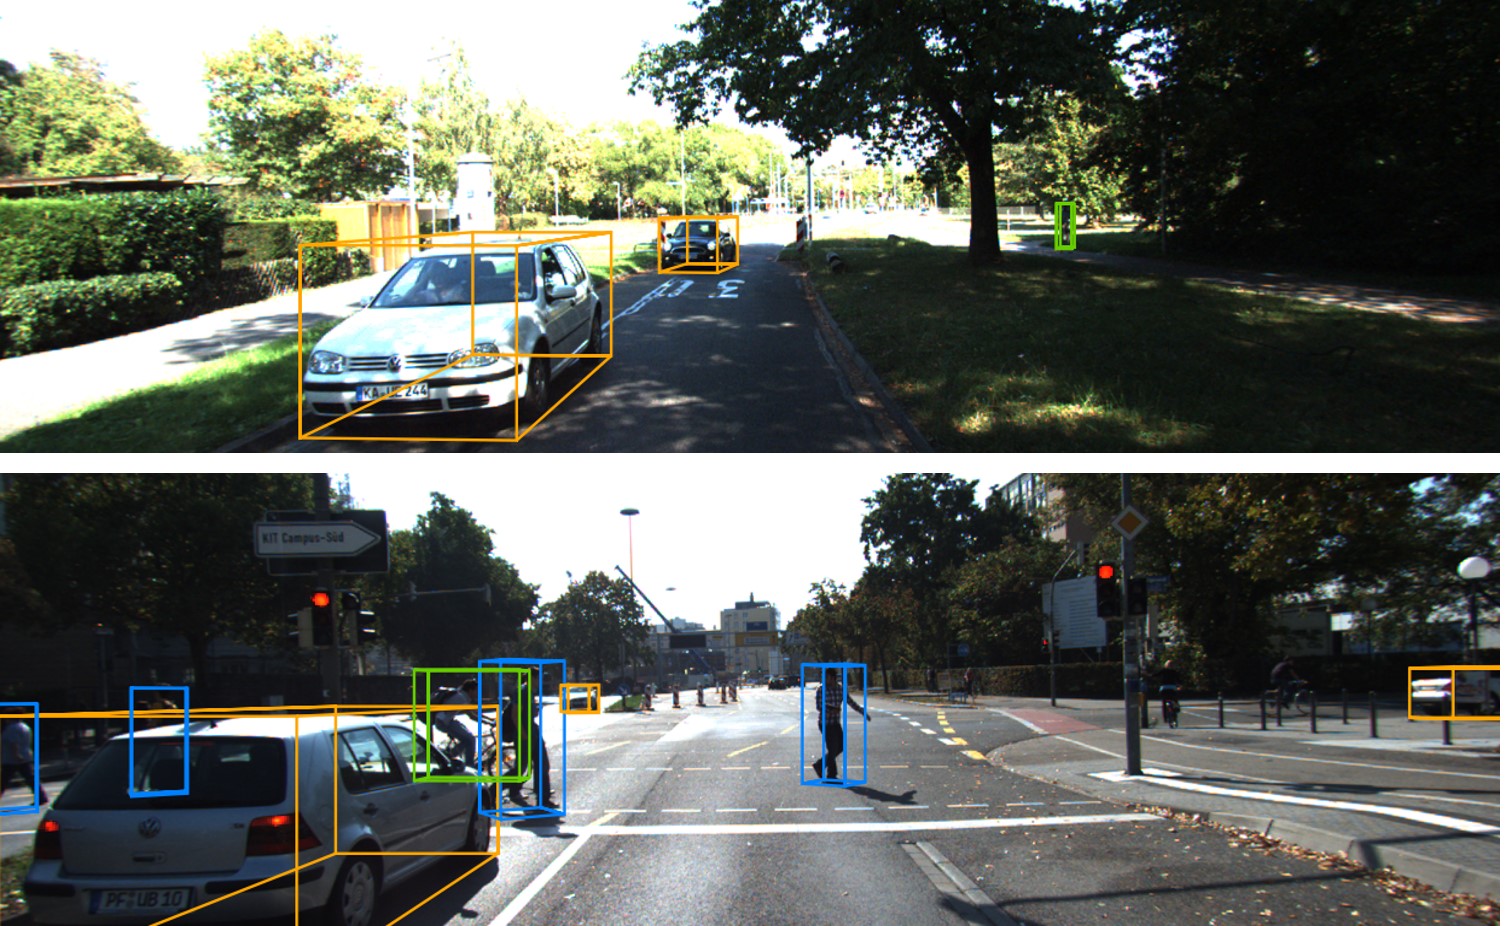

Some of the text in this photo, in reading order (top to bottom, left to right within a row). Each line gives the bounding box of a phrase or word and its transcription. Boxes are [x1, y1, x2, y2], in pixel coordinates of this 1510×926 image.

[262, 530, 345, 546] KIT Campus-Süd
[105, 890, 183, 908] PF UB 10
